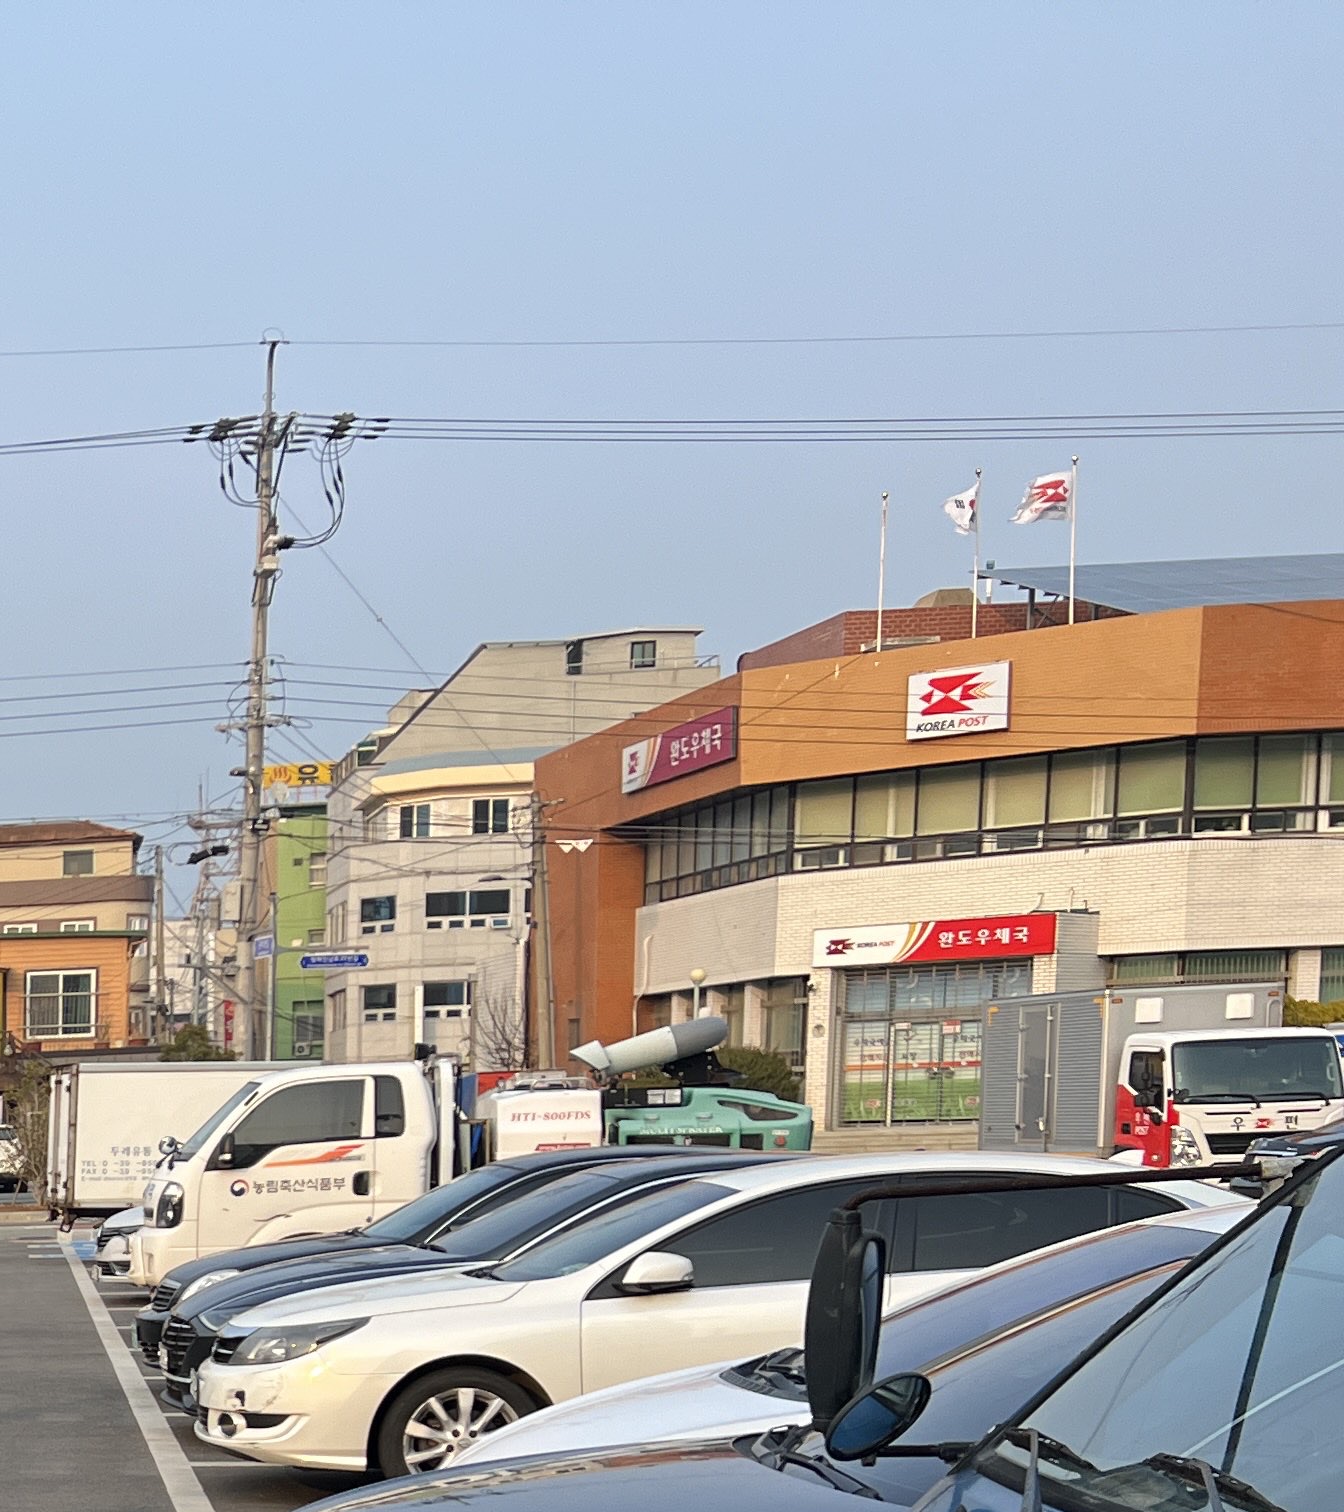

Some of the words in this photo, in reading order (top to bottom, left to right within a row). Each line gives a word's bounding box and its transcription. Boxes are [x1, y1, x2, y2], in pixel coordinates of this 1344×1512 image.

[916, 722, 955, 733] KOREA
[958, 715, 988, 728] POST
[670, 724, 723, 768] 완도우체국
[937, 926, 1031, 949] 완도우체국
[252, 1177, 347, 1195] 농림축산식품부
